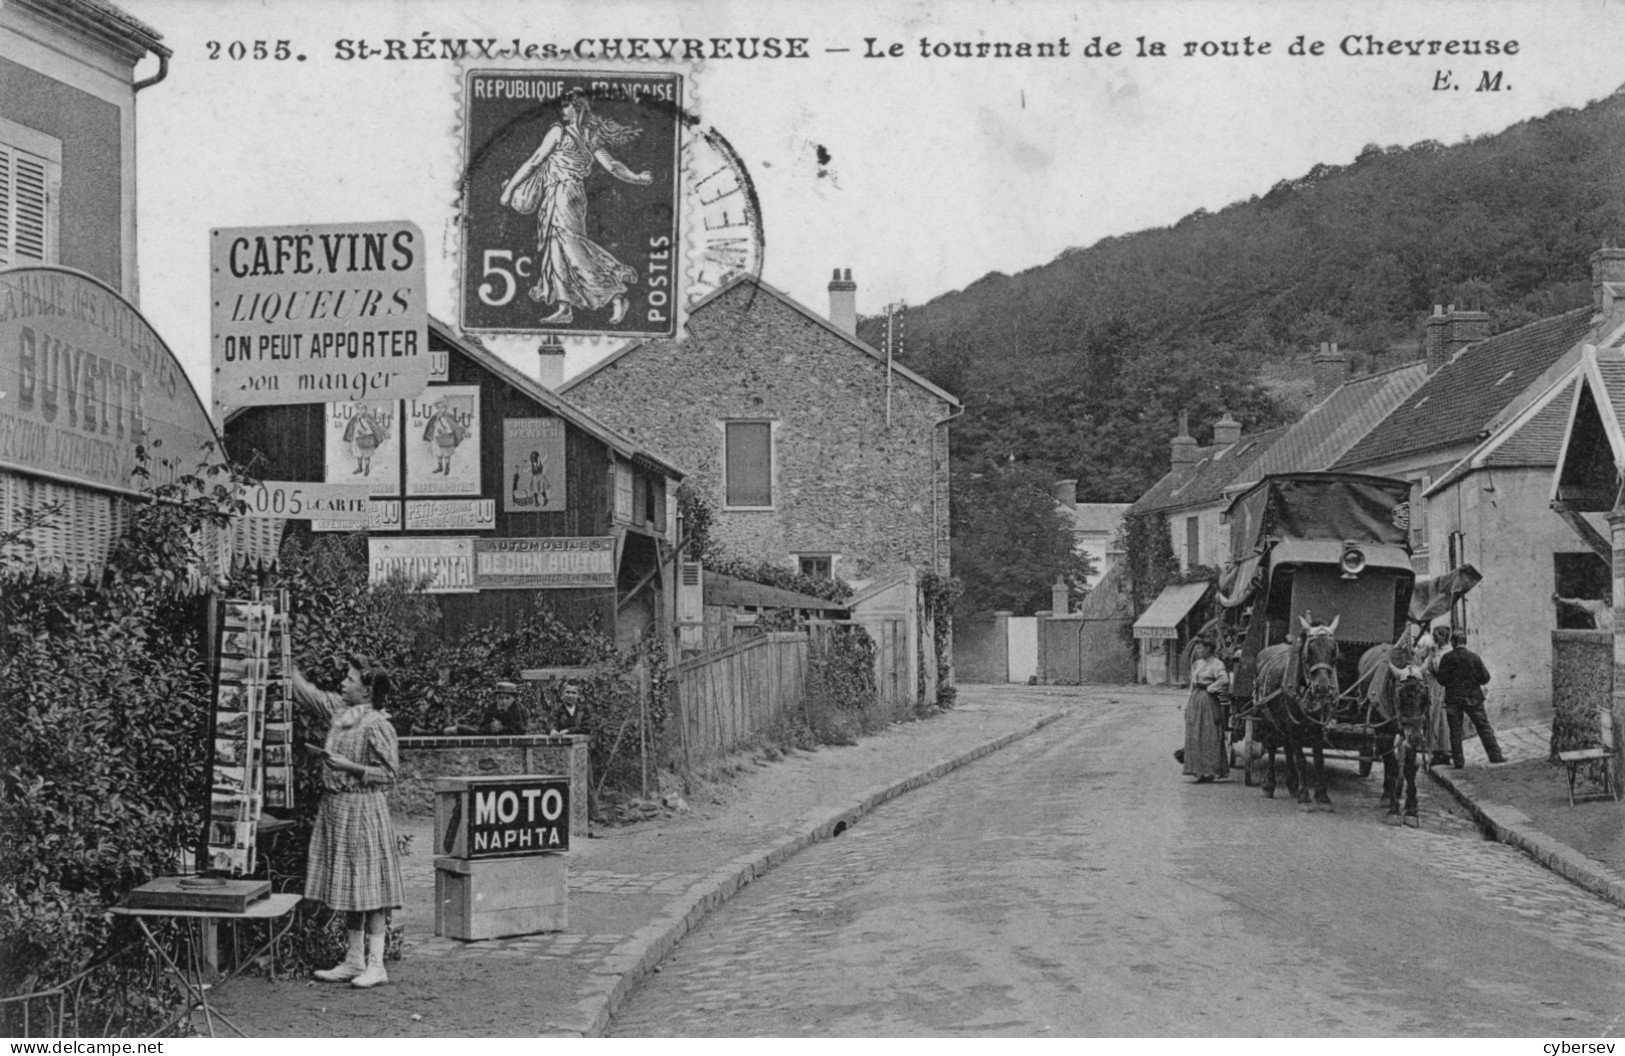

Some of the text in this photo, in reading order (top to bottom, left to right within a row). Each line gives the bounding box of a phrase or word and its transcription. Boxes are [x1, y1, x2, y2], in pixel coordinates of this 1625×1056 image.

[319, 230, 414, 273] VINS
[648, 235, 670, 322] POSTES
[231, 287, 412, 324] LIQUEURS
[225, 330, 418, 362] ON PEUT APPORTER
[18, 326, 147, 445] BUVETTE
[298, 371, 400, 401] manger
[332, 401, 352, 420] LU
[411, 399, 432, 419] LU
[453, 407, 471, 428] LU
[315, 499, 366, 512] CARTE
[382, 502, 400, 525] LU
[476, 501, 495, 523] LU
[488, 540, 603, 552] AUTOMOBILES
[475, 788, 563, 825] MOTO
[474, 826, 560, 850] NAPHTA
